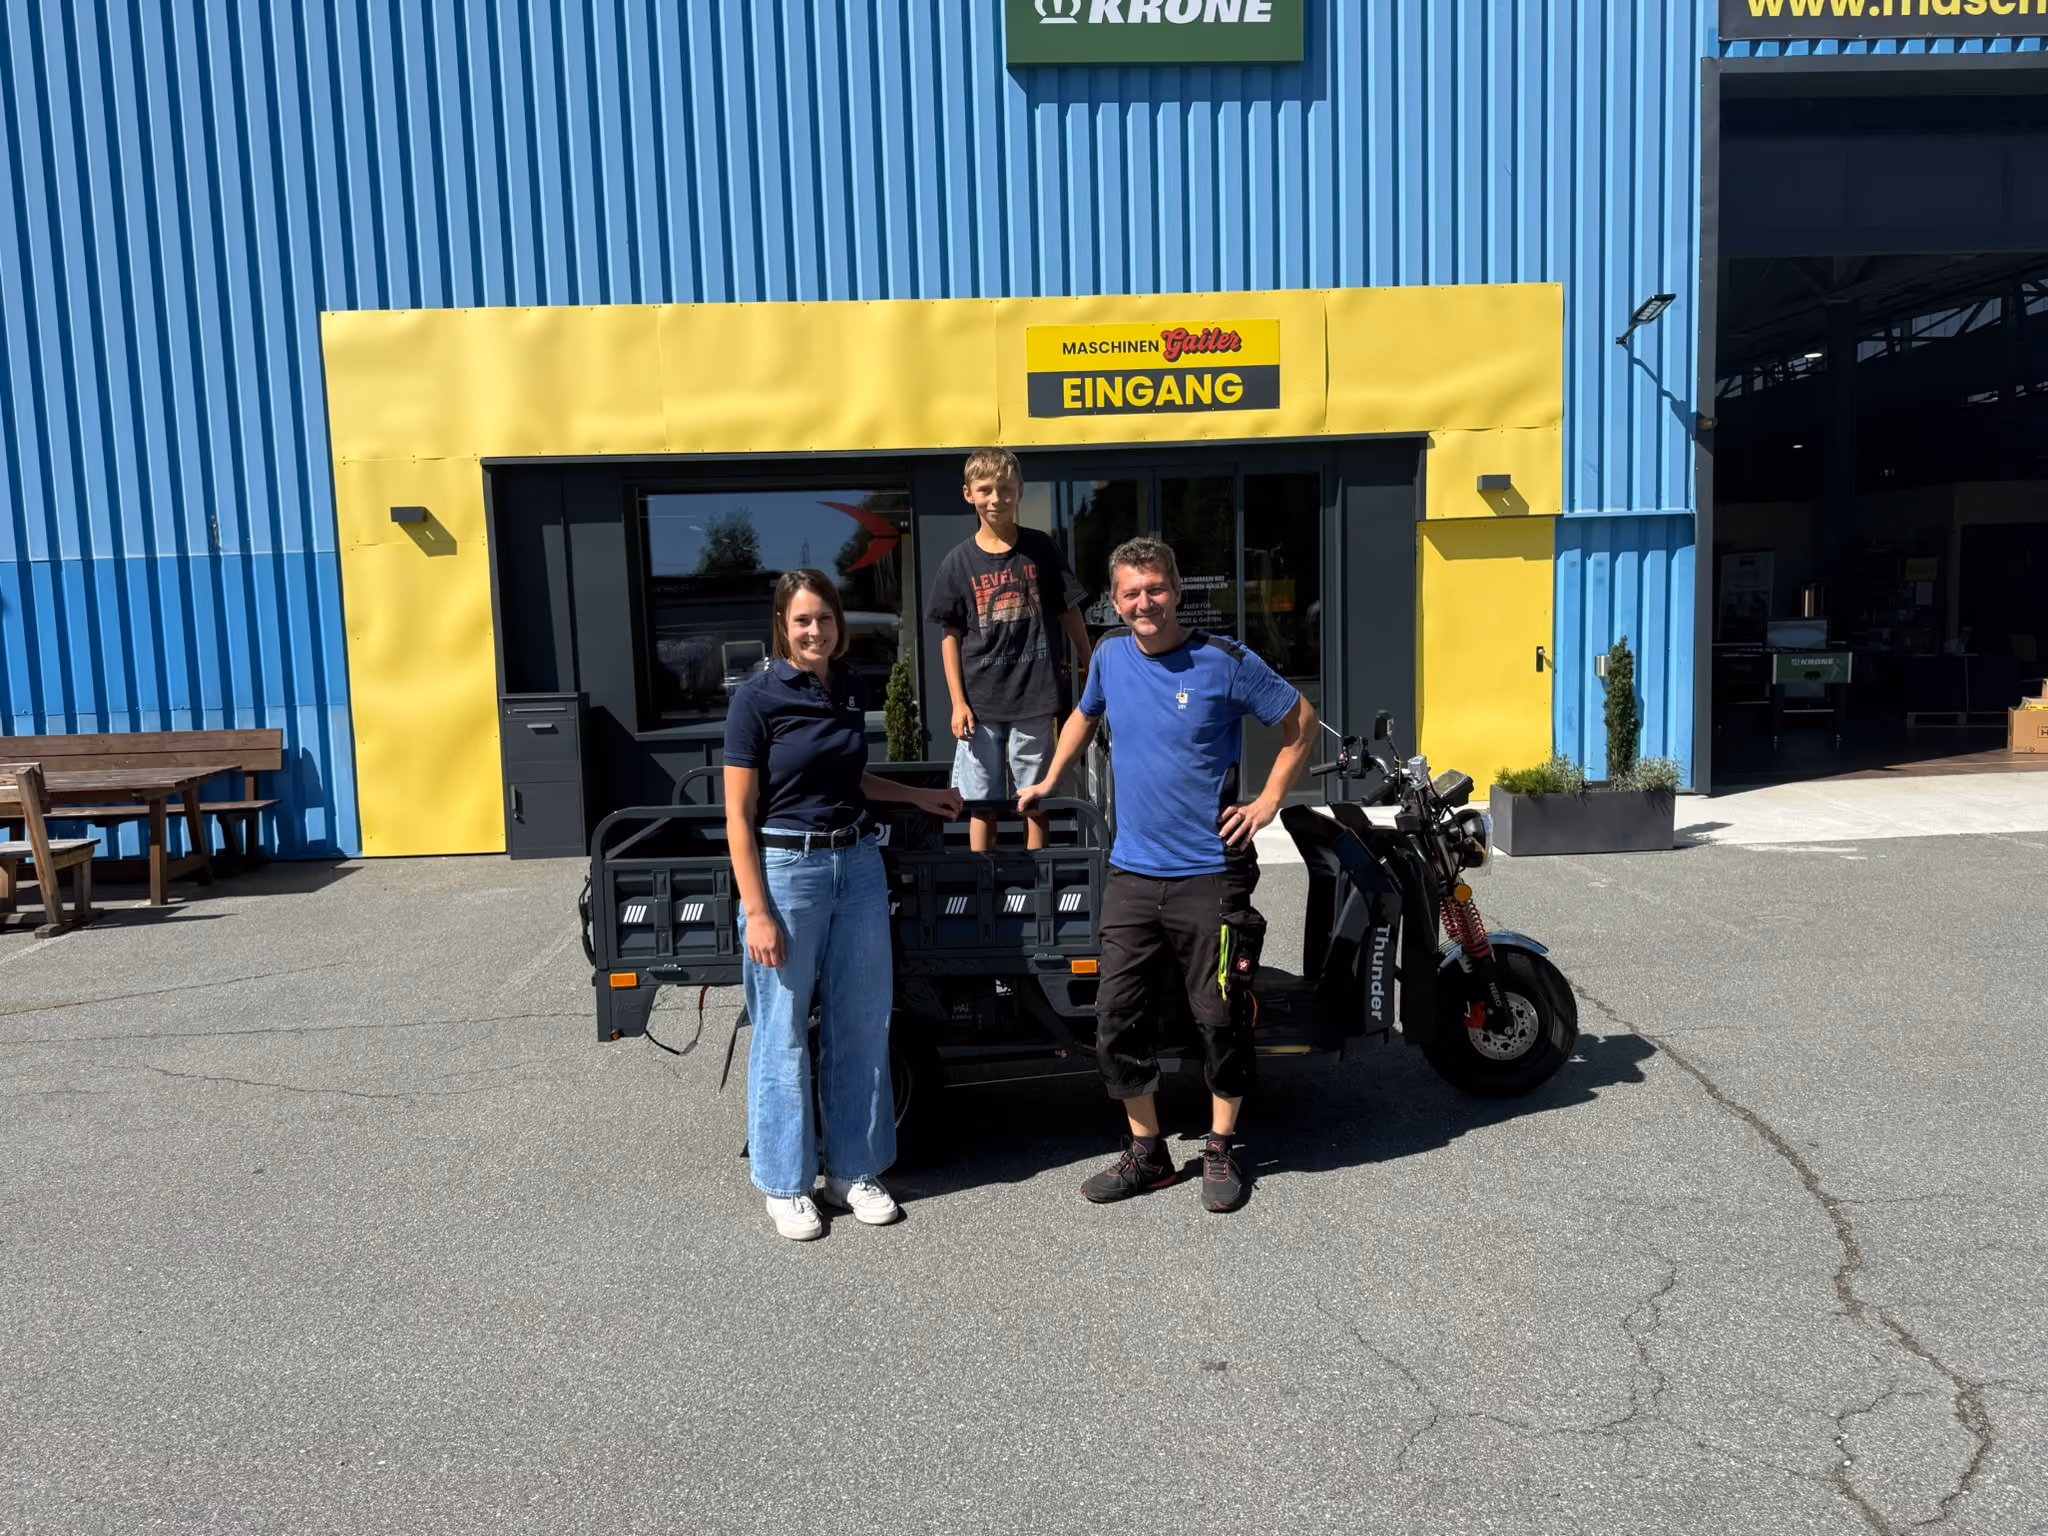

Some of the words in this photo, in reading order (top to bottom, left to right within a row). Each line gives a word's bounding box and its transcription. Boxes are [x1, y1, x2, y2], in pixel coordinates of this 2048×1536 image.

[1087, 0, 1273, 23] KRONE
[1062, 340, 1160, 355] MASCHINEN
[1161, 327, 1243, 363] Gailer
[1063, 373, 1244, 409] EINGANG
[971, 567, 1019, 591] LEVEL
[1370, 923, 1391, 1021] Thunder
[1487, 982, 1503, 1008] NERO
